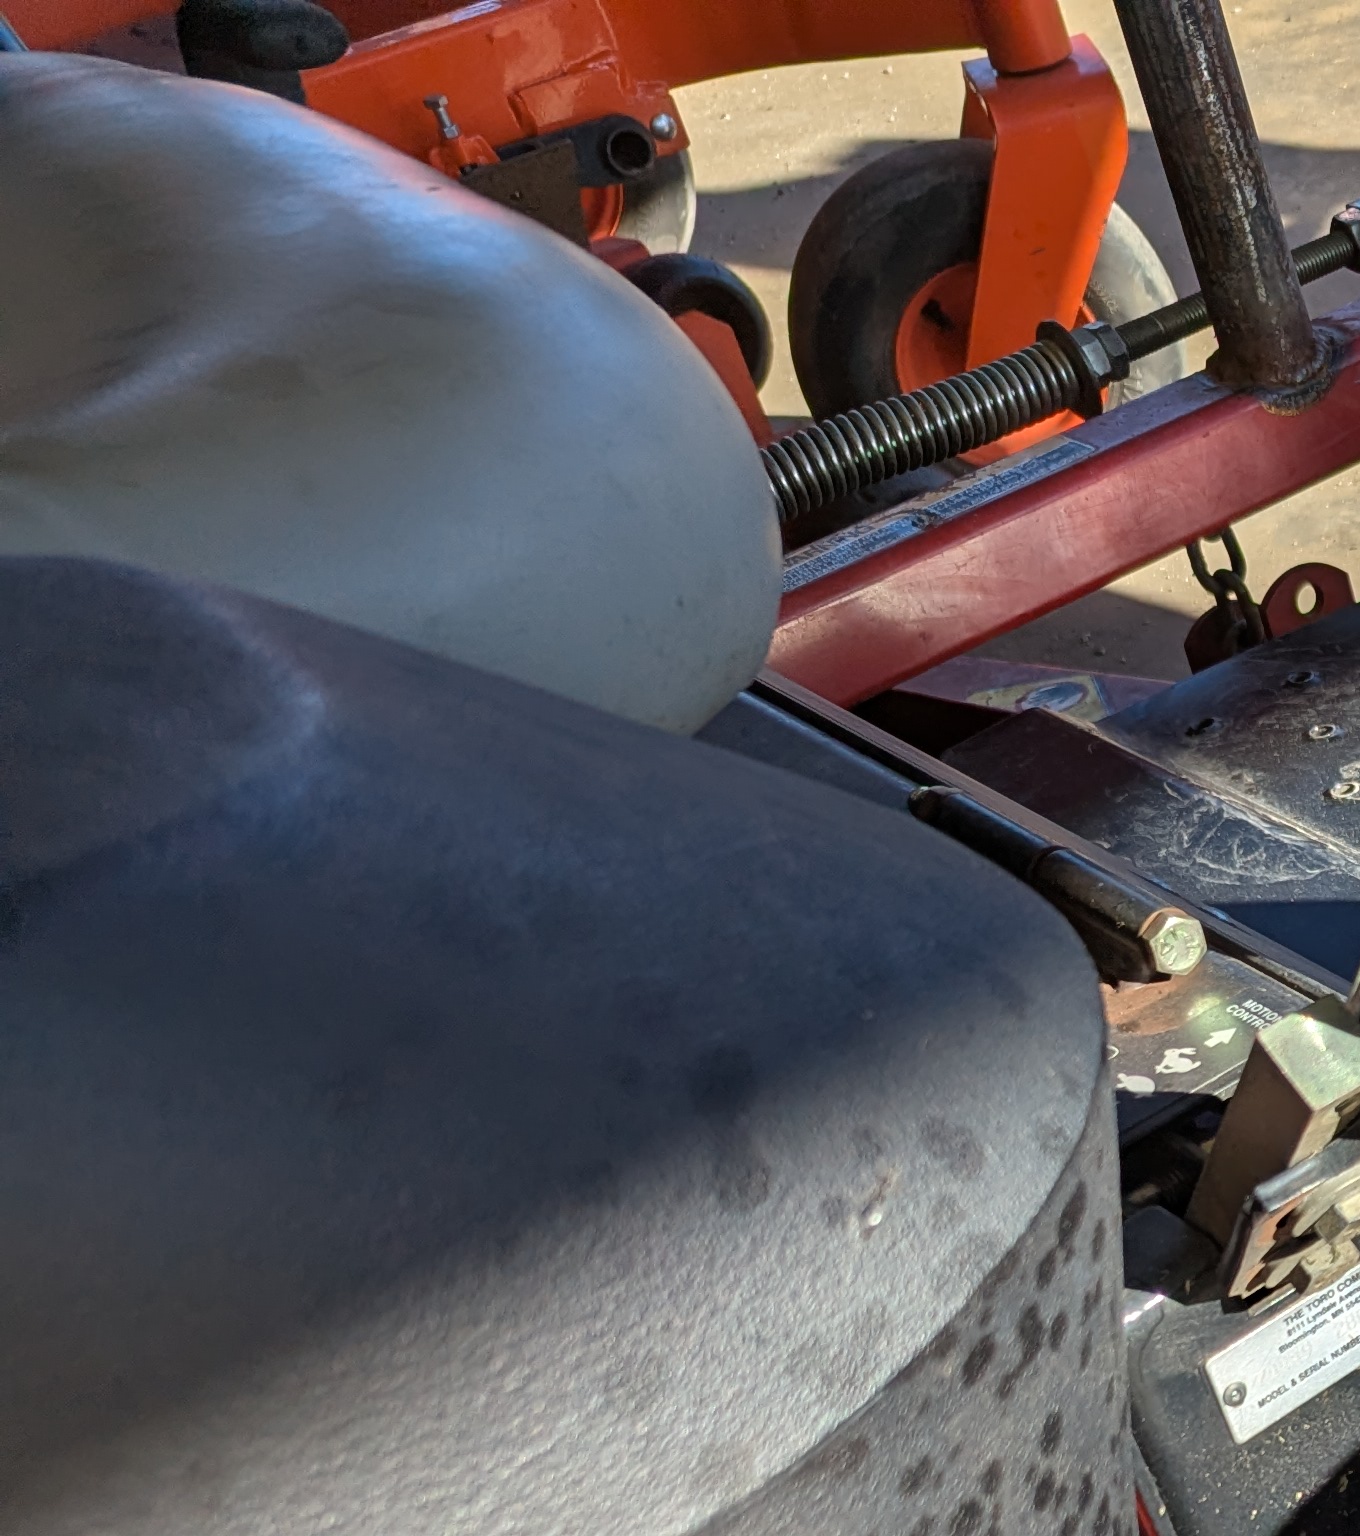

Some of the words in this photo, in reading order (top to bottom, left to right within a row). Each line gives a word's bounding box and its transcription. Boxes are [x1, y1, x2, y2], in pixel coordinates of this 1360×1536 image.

[1226, 1005, 1273, 1031] CONTRO
[1242, 999, 1283, 1023] MOTION
[1283, 1307, 1305, 1327] THE
[1306, 1288, 1335, 1312] TORO
[1257, 1382, 1289, 1408] MODEL
[1290, 1377, 1297, 1387] &
[1298, 1355, 1330, 1381] SERIAL
